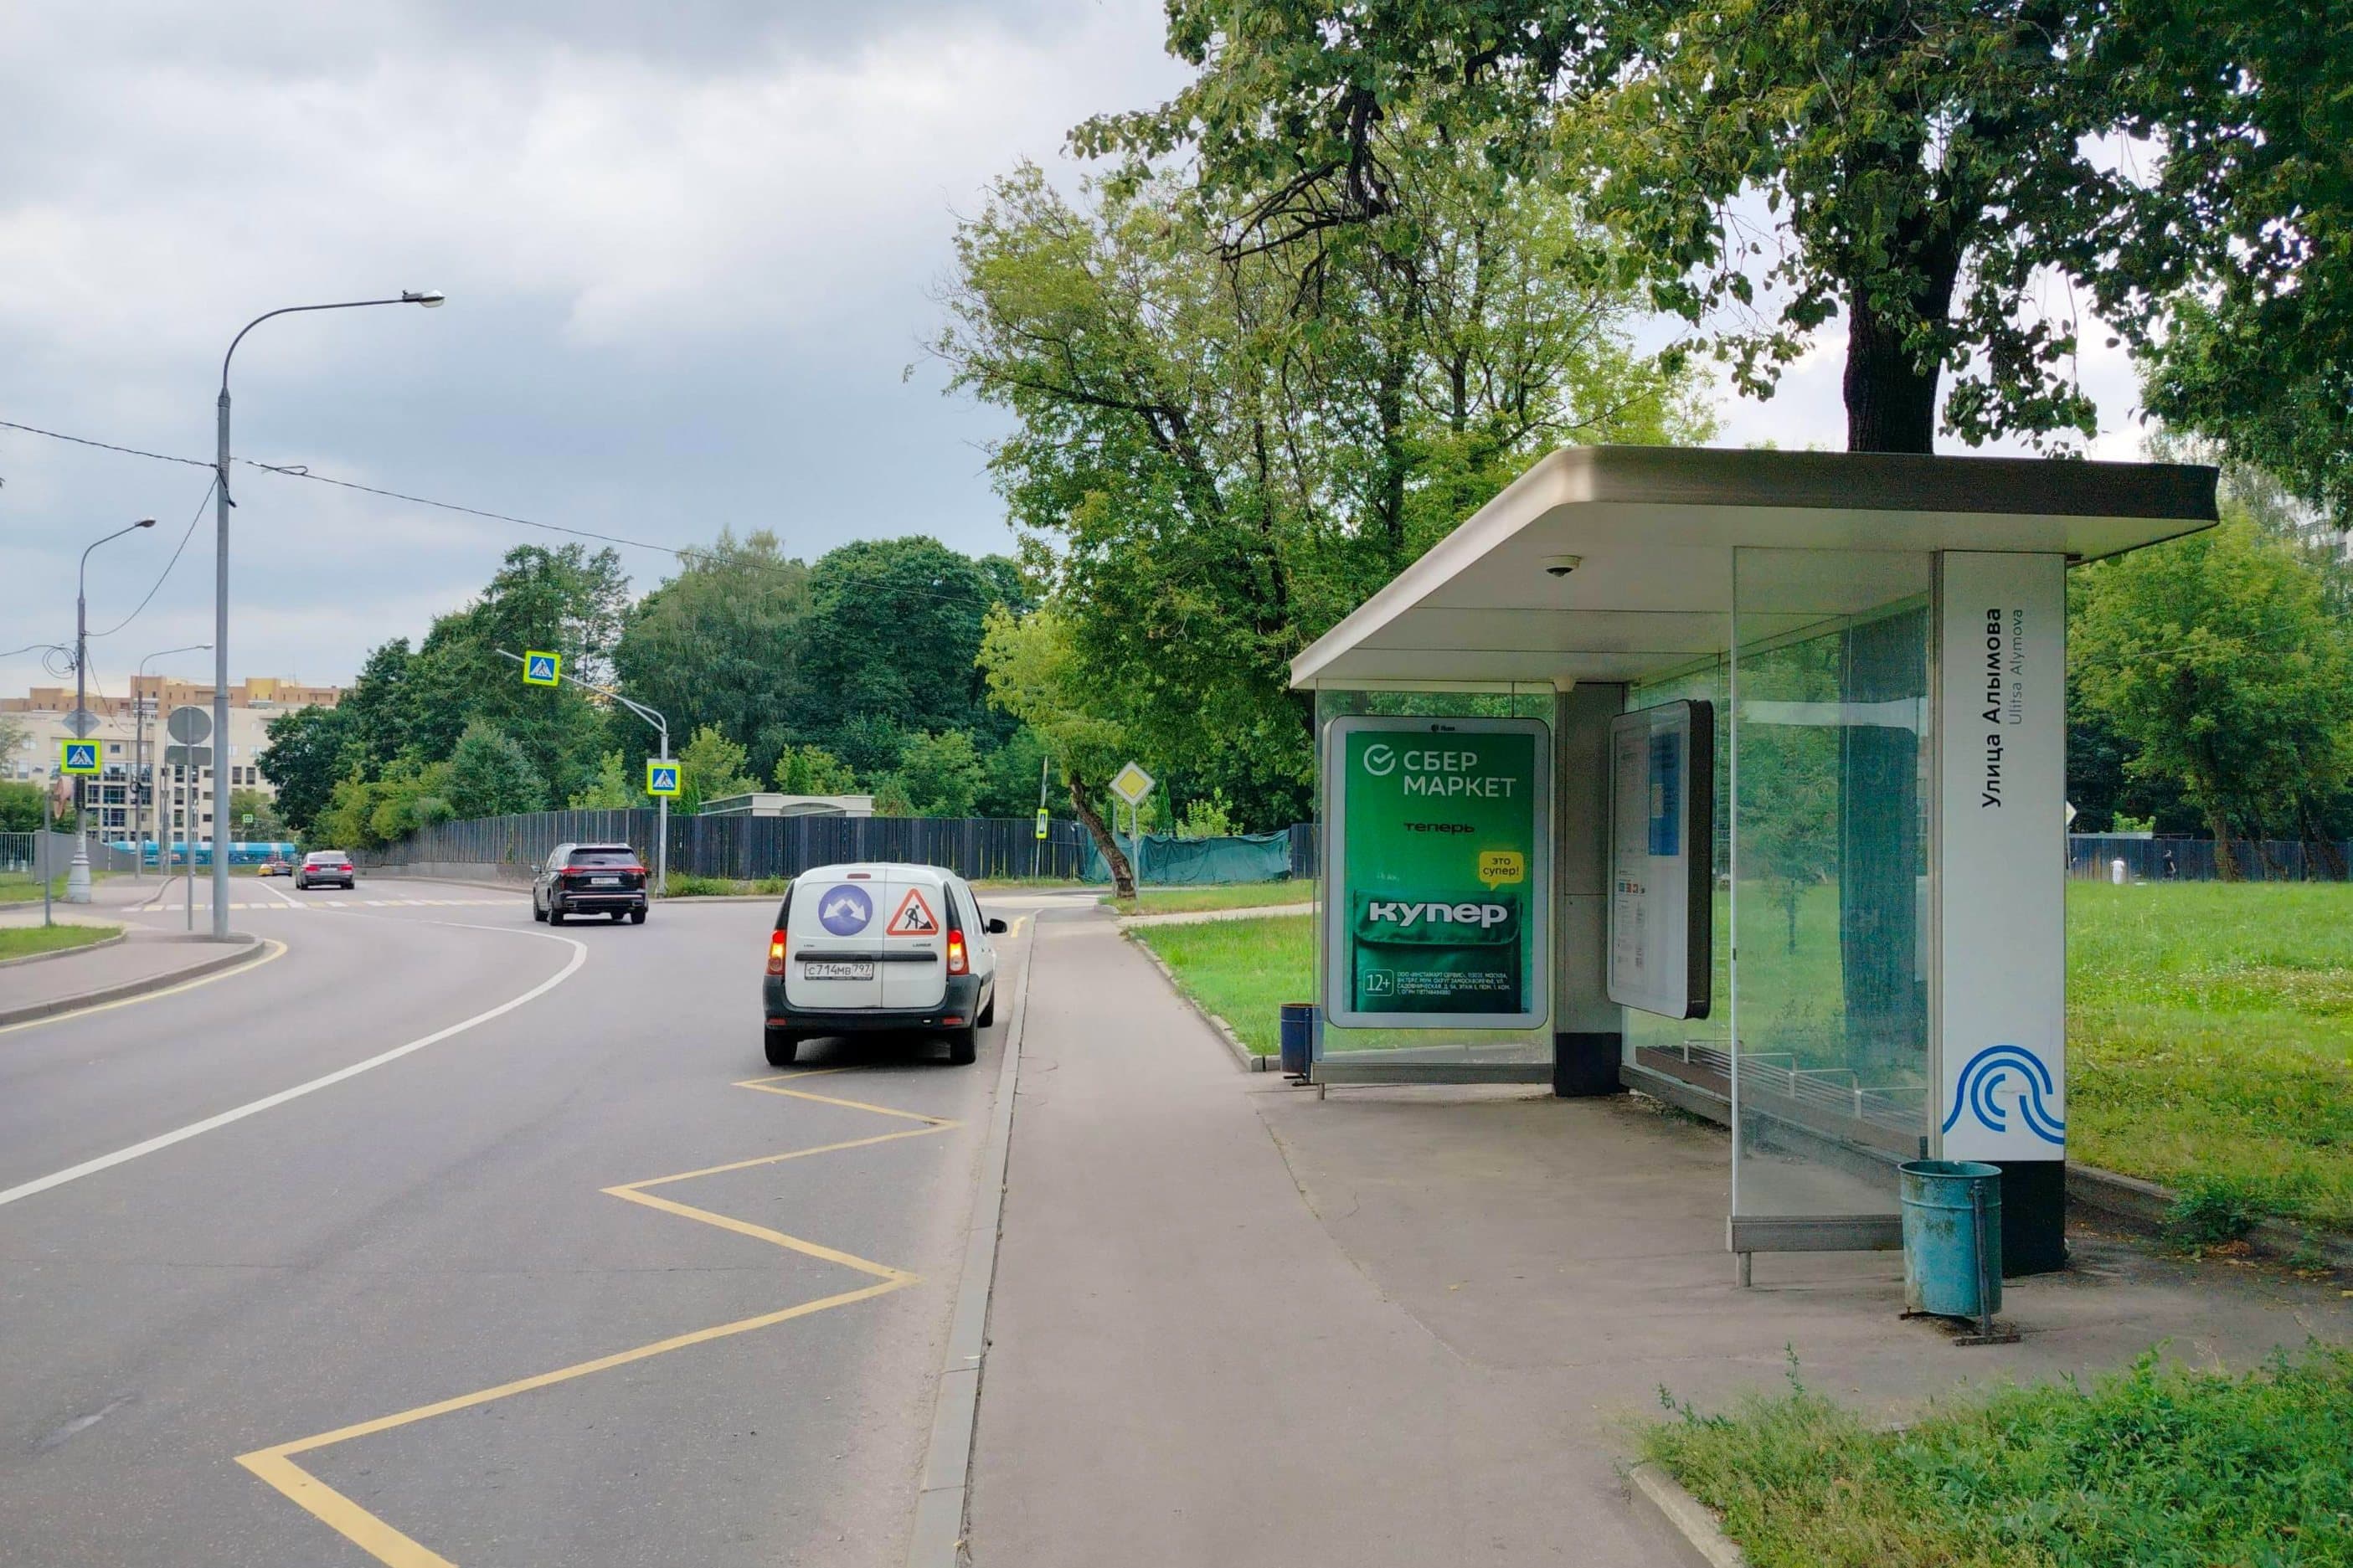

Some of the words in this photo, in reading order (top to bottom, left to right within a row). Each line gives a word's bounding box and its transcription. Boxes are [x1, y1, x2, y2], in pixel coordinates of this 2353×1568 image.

[2009, 609, 2025, 676] Alymova
[1982, 609, 2000, 724] Алымова
[2009, 682, 2022, 725] Ulitsa
[1403, 750, 1478, 772] СБЕР
[1982, 734, 2004, 808] Улица
[1403, 775, 1516, 797] МАРКЕТ
[1403, 822, 1475, 835] теперь
[1483, 866, 1519, 877] супер!
[1492, 857, 1511, 866] это
[1369, 902, 1508, 928] купер
[852, 964, 870, 973] 797
[1367, 974, 1391, 991] 12+
